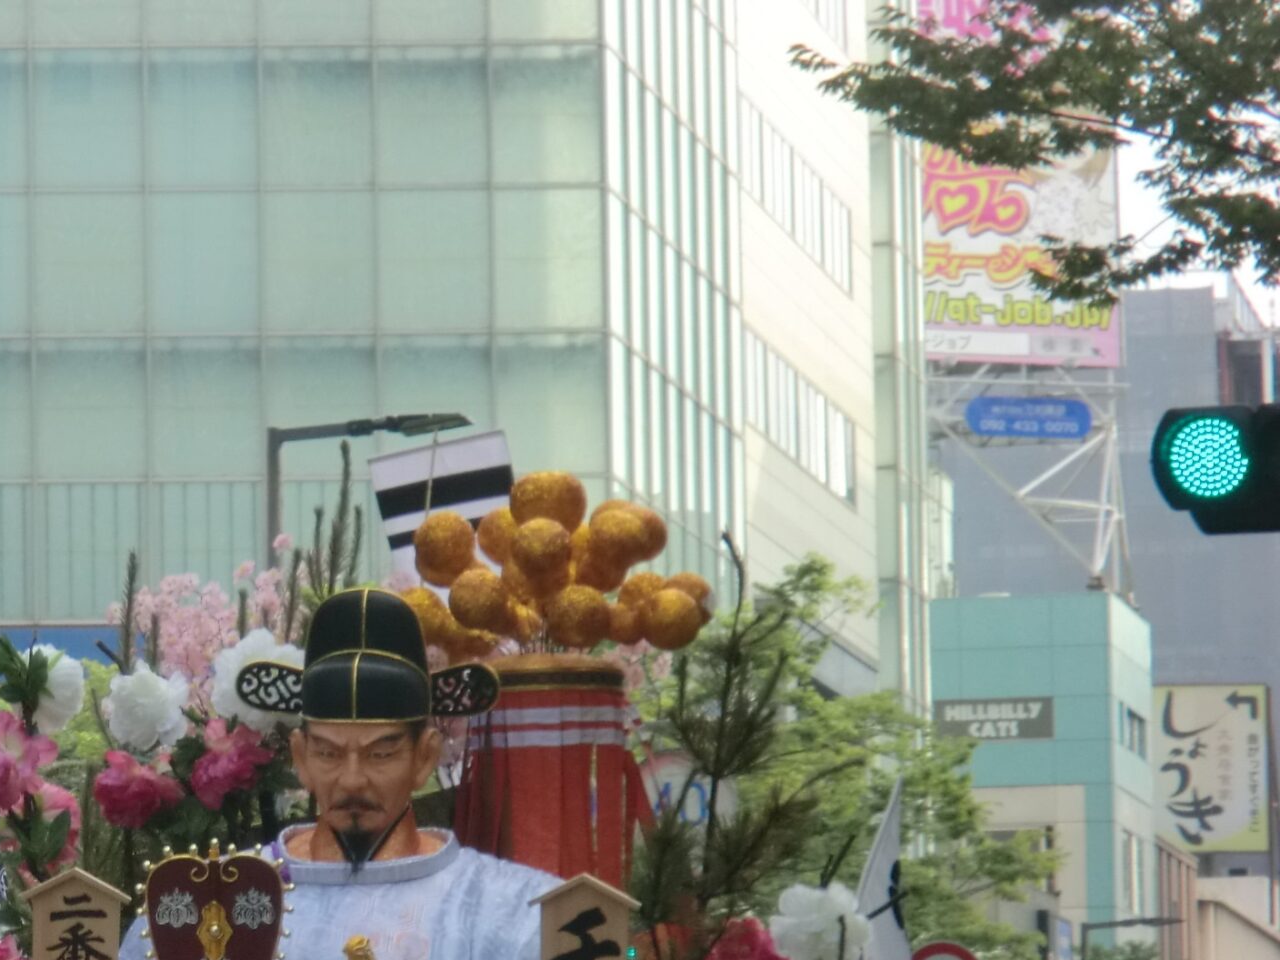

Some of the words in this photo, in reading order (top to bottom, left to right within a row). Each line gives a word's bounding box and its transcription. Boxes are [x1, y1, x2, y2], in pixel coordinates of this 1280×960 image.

[945, 702, 1042, 721] HILLBILLY
[1160, 690, 1225, 846] しょうき
